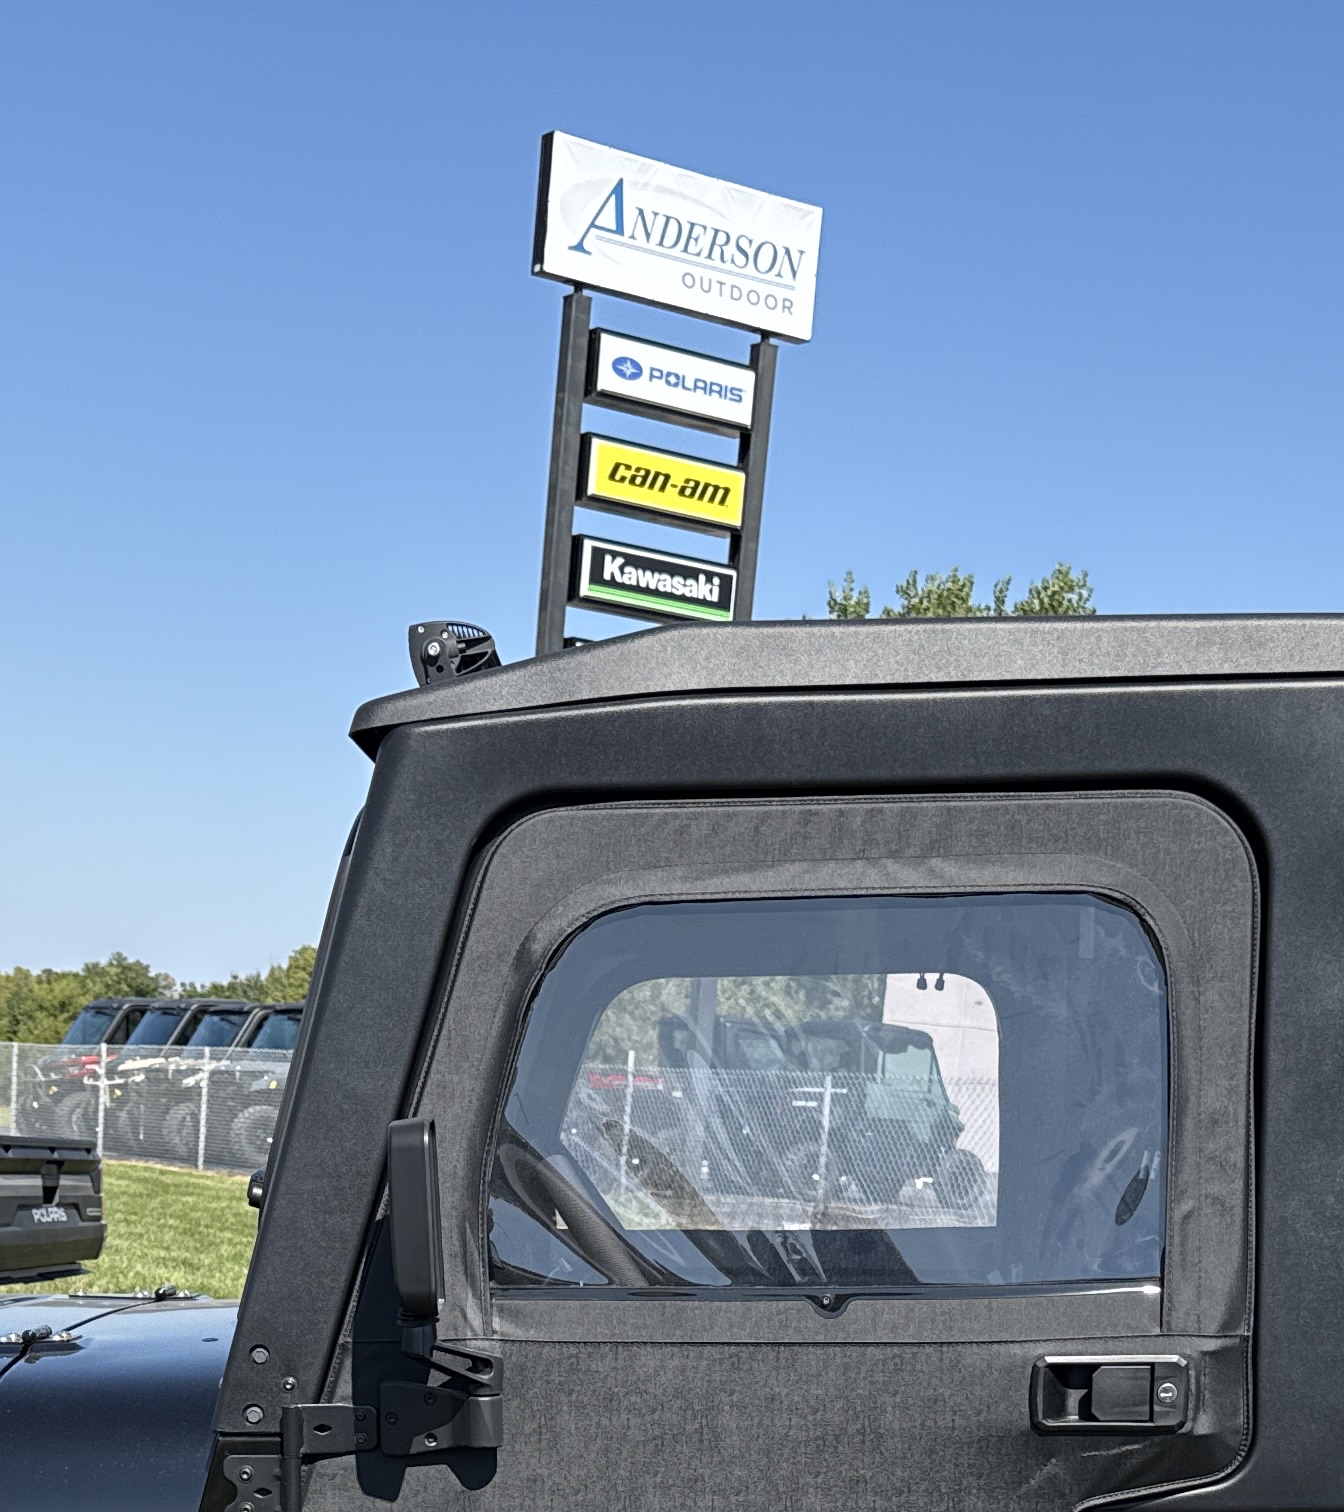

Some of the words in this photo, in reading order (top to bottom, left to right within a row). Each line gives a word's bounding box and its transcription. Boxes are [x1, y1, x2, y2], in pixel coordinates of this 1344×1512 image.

[568, 177, 806, 281] ANDERSON
[681, 272, 794, 315] OUTDOOR
[649, 366, 744, 403] POLARIS
[608, 461, 731, 507] can-am
[603, 554, 721, 602] Kawasaki
